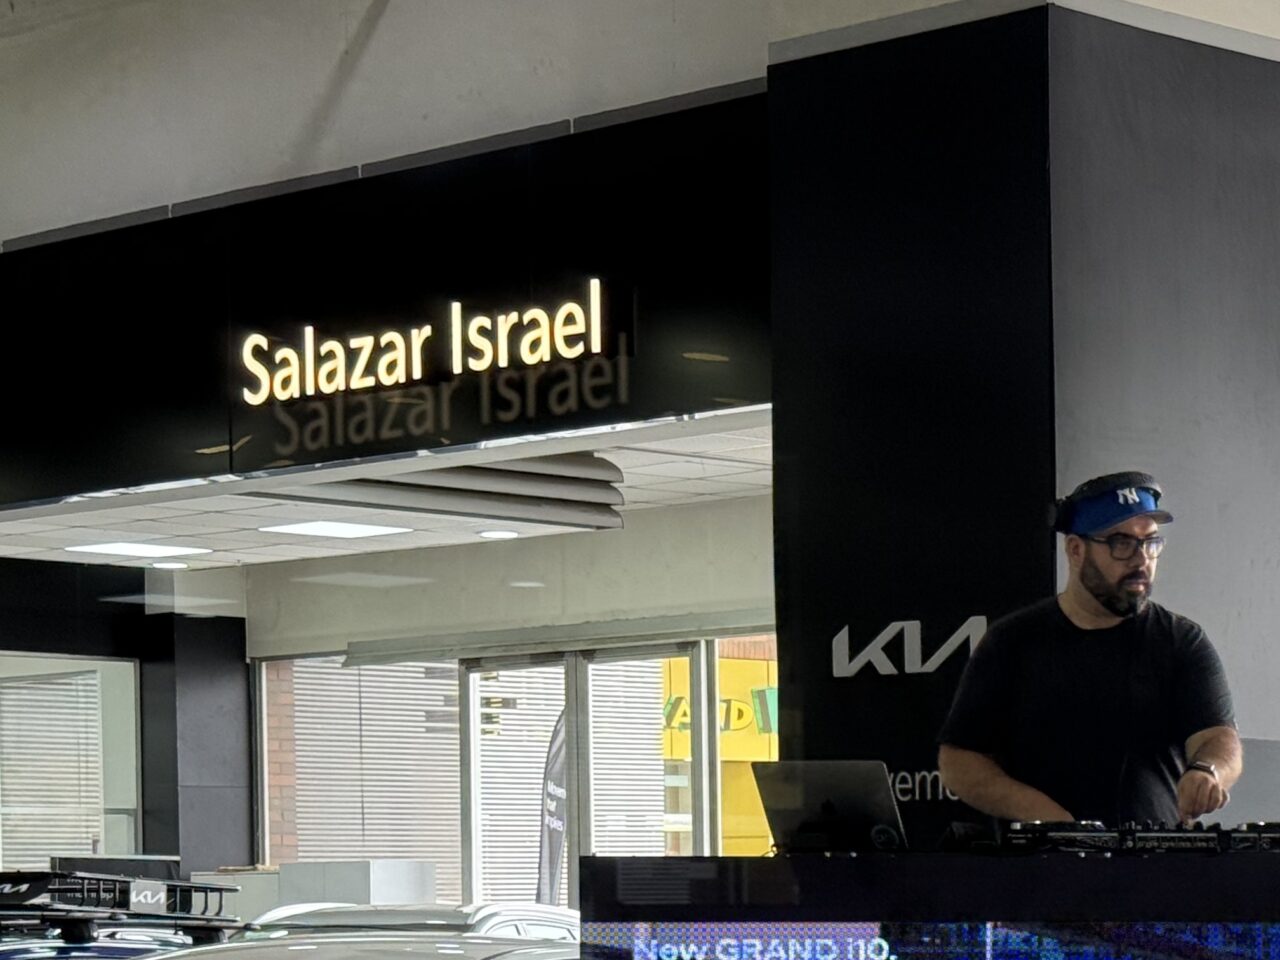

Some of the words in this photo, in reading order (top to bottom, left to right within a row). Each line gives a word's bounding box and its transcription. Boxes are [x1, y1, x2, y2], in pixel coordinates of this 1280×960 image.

[242, 325, 432, 406] Salazar
[451, 278, 602, 375] Israel
[832, 615, 987, 678] KIA
[131, 890, 168, 904] KIA
[634, 939, 707, 960] New
